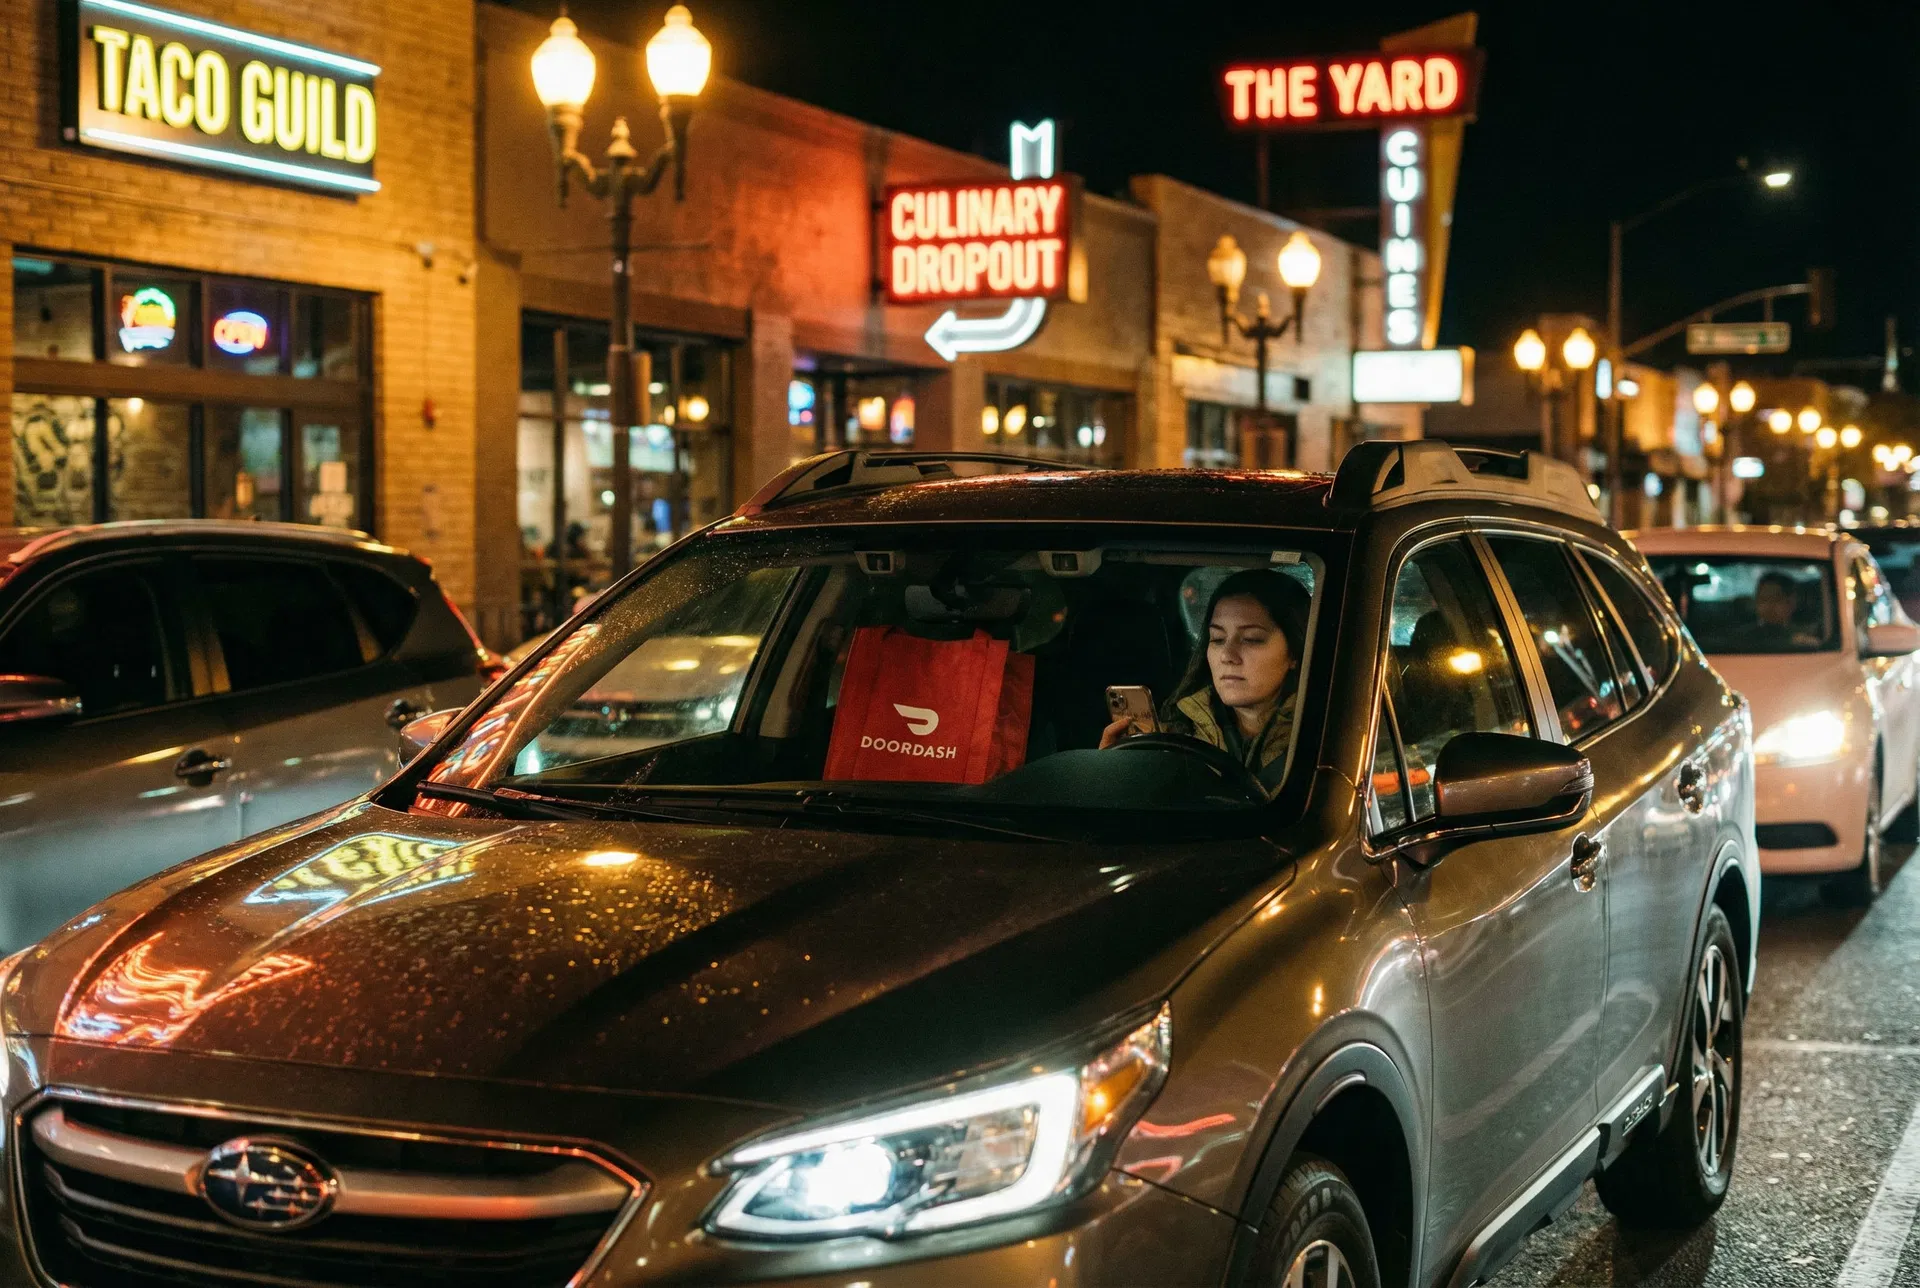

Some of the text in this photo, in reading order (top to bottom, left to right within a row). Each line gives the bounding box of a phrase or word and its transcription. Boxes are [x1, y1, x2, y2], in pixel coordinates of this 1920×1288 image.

[93, 25, 377, 164] TACO GUILD
[1224, 57, 1459, 121] THE YARD
[891, 184, 1063, 241] CULINARY
[891, 238, 1063, 296] DROPOUT
[860, 735, 957, 759] DOORDASH
